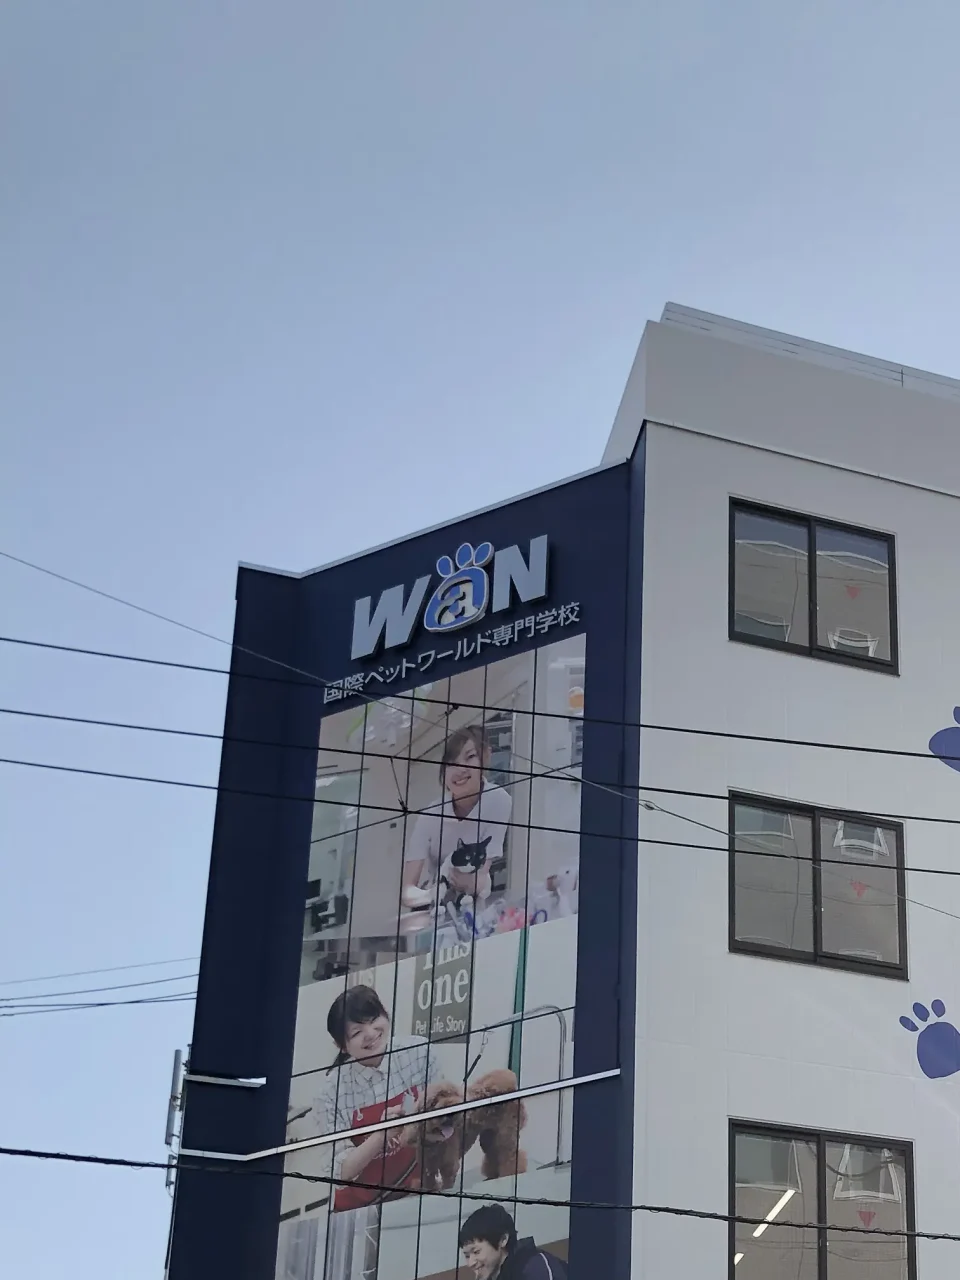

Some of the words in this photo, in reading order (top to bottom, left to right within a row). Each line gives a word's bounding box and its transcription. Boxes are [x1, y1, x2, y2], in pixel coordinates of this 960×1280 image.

[323, 601, 581, 705] 国際ペットワールド専門学校
[417, 969, 469, 1010] one
[415, 1019, 427, 1035] Pet
[430, 1016, 444, 1033] ife
[446, 1014, 466, 1034] Story
